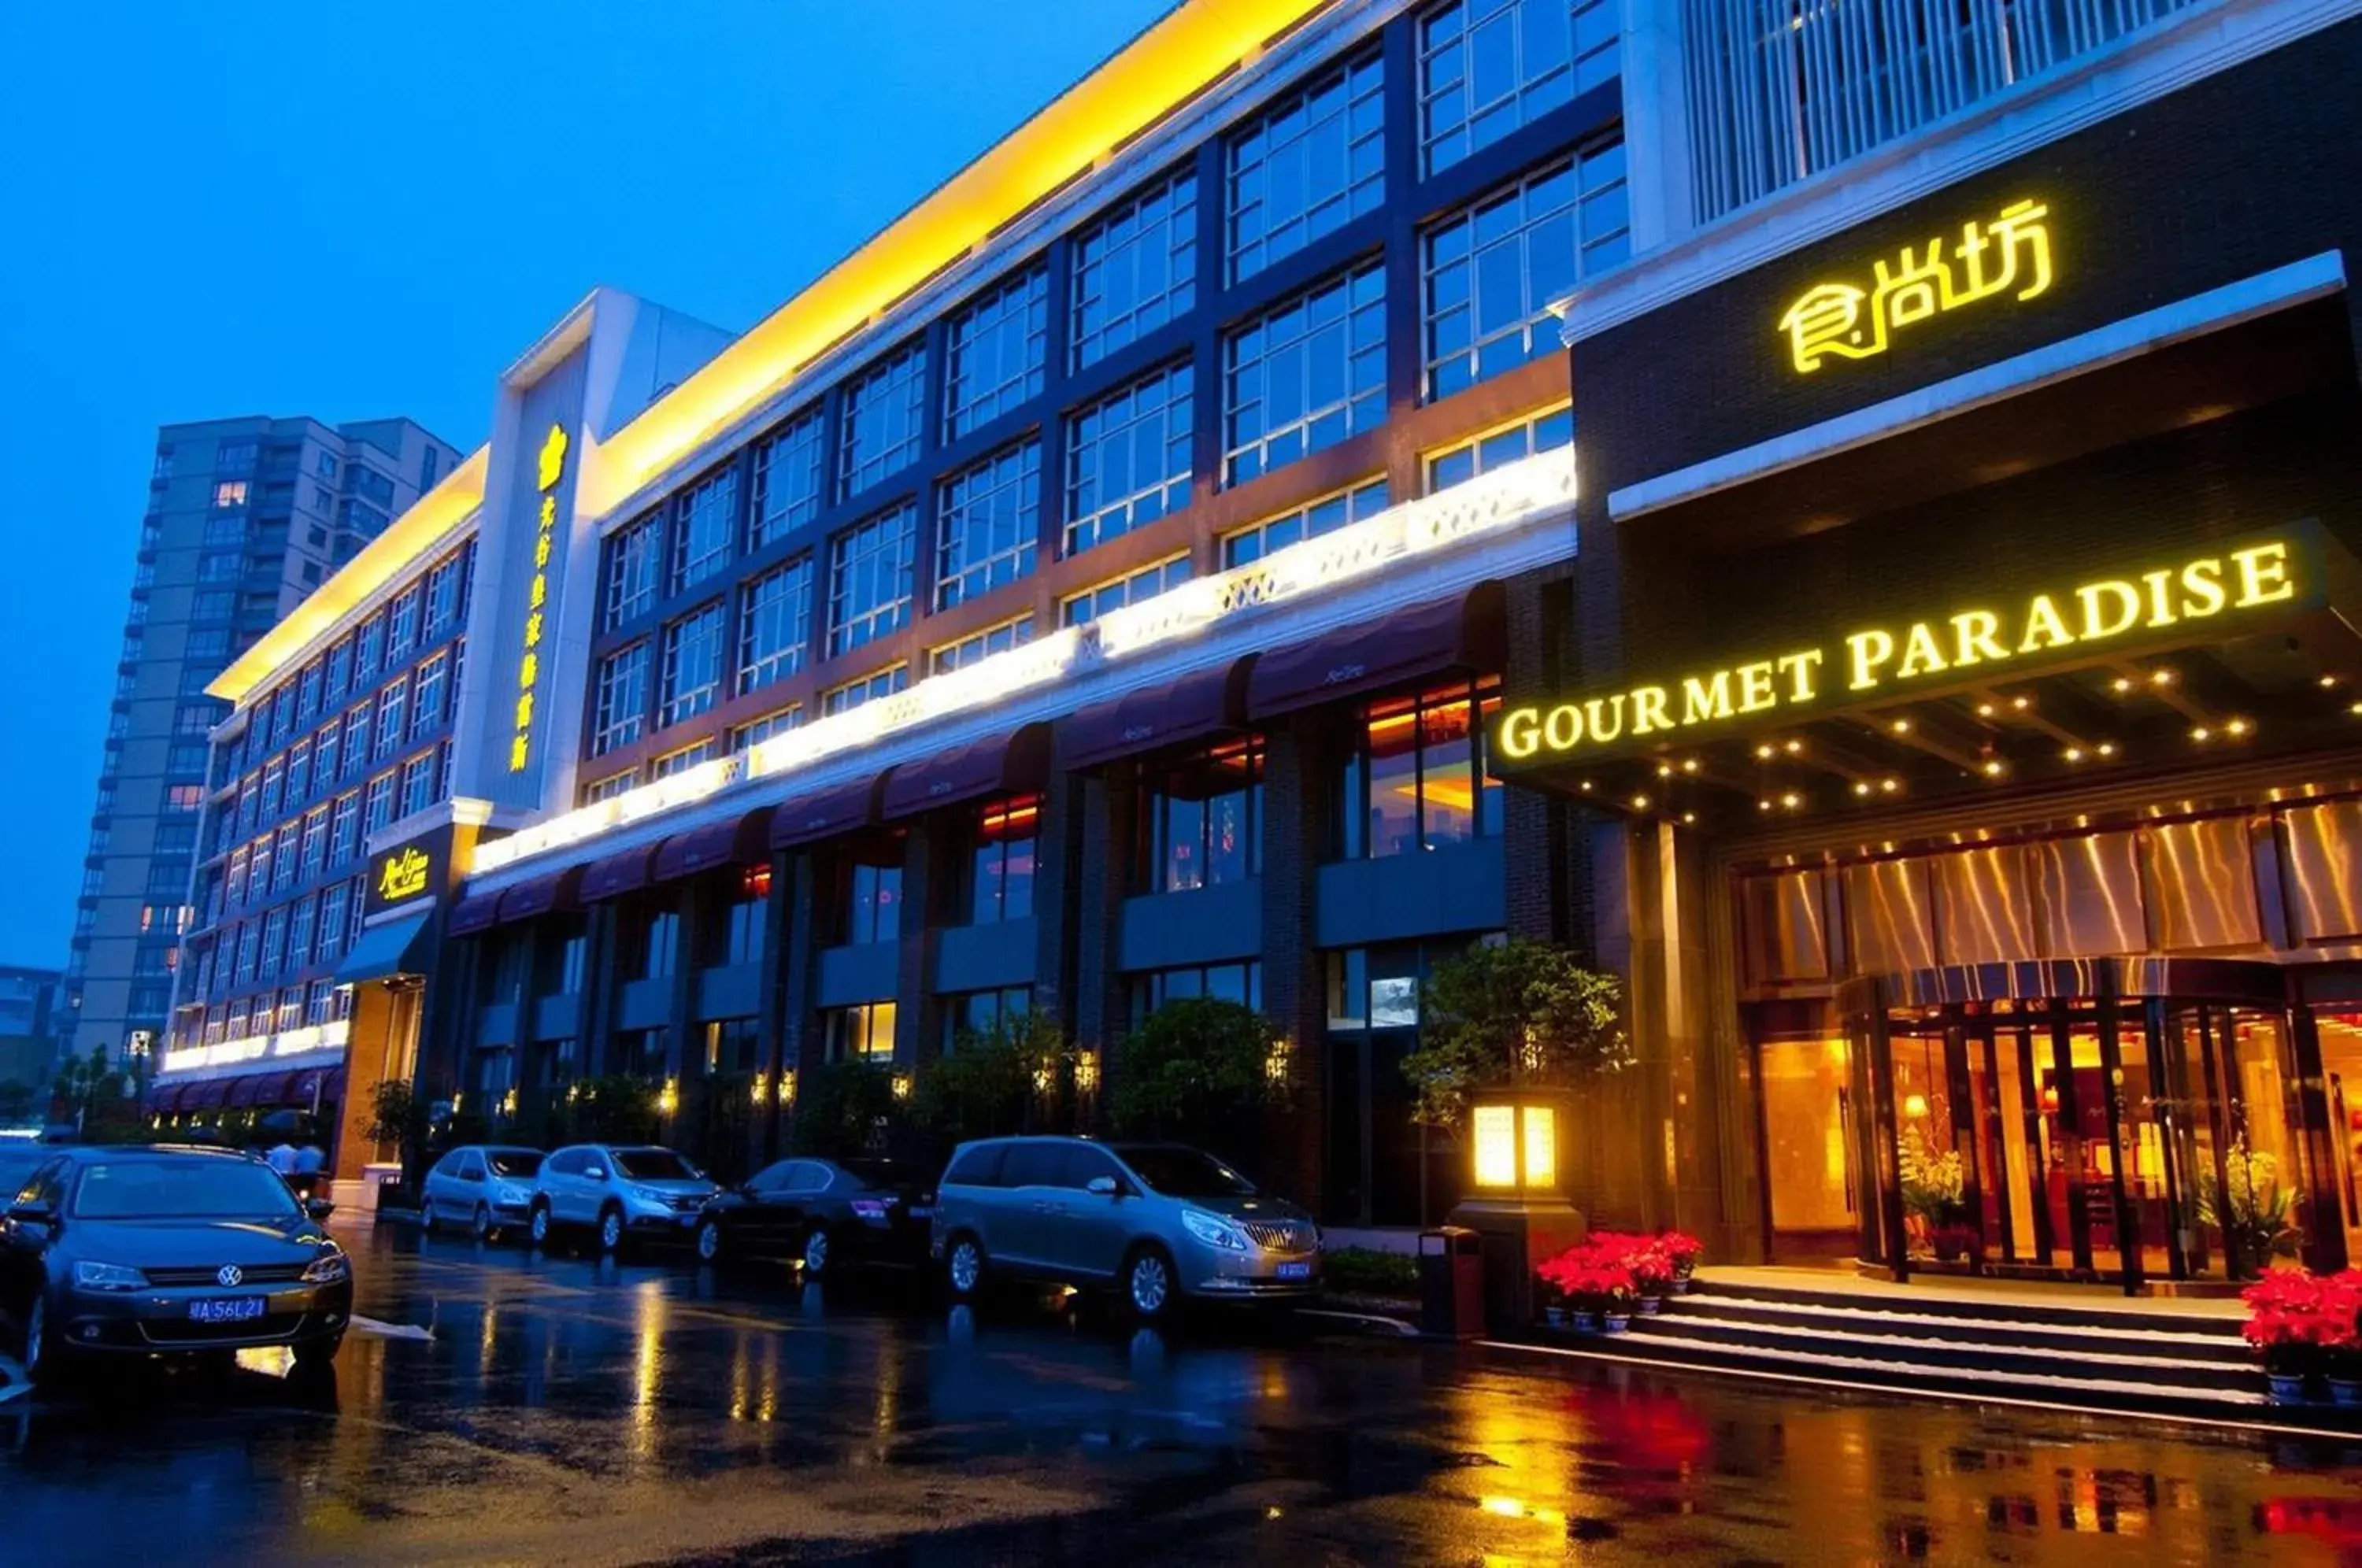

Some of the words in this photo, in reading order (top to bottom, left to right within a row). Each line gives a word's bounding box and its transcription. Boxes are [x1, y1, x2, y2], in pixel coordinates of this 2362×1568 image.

[1778, 199, 2052, 373] 食尚坊
[1500, 648, 1823, 757] GOURMET
[1846, 542, 2294, 690] PARADISE
